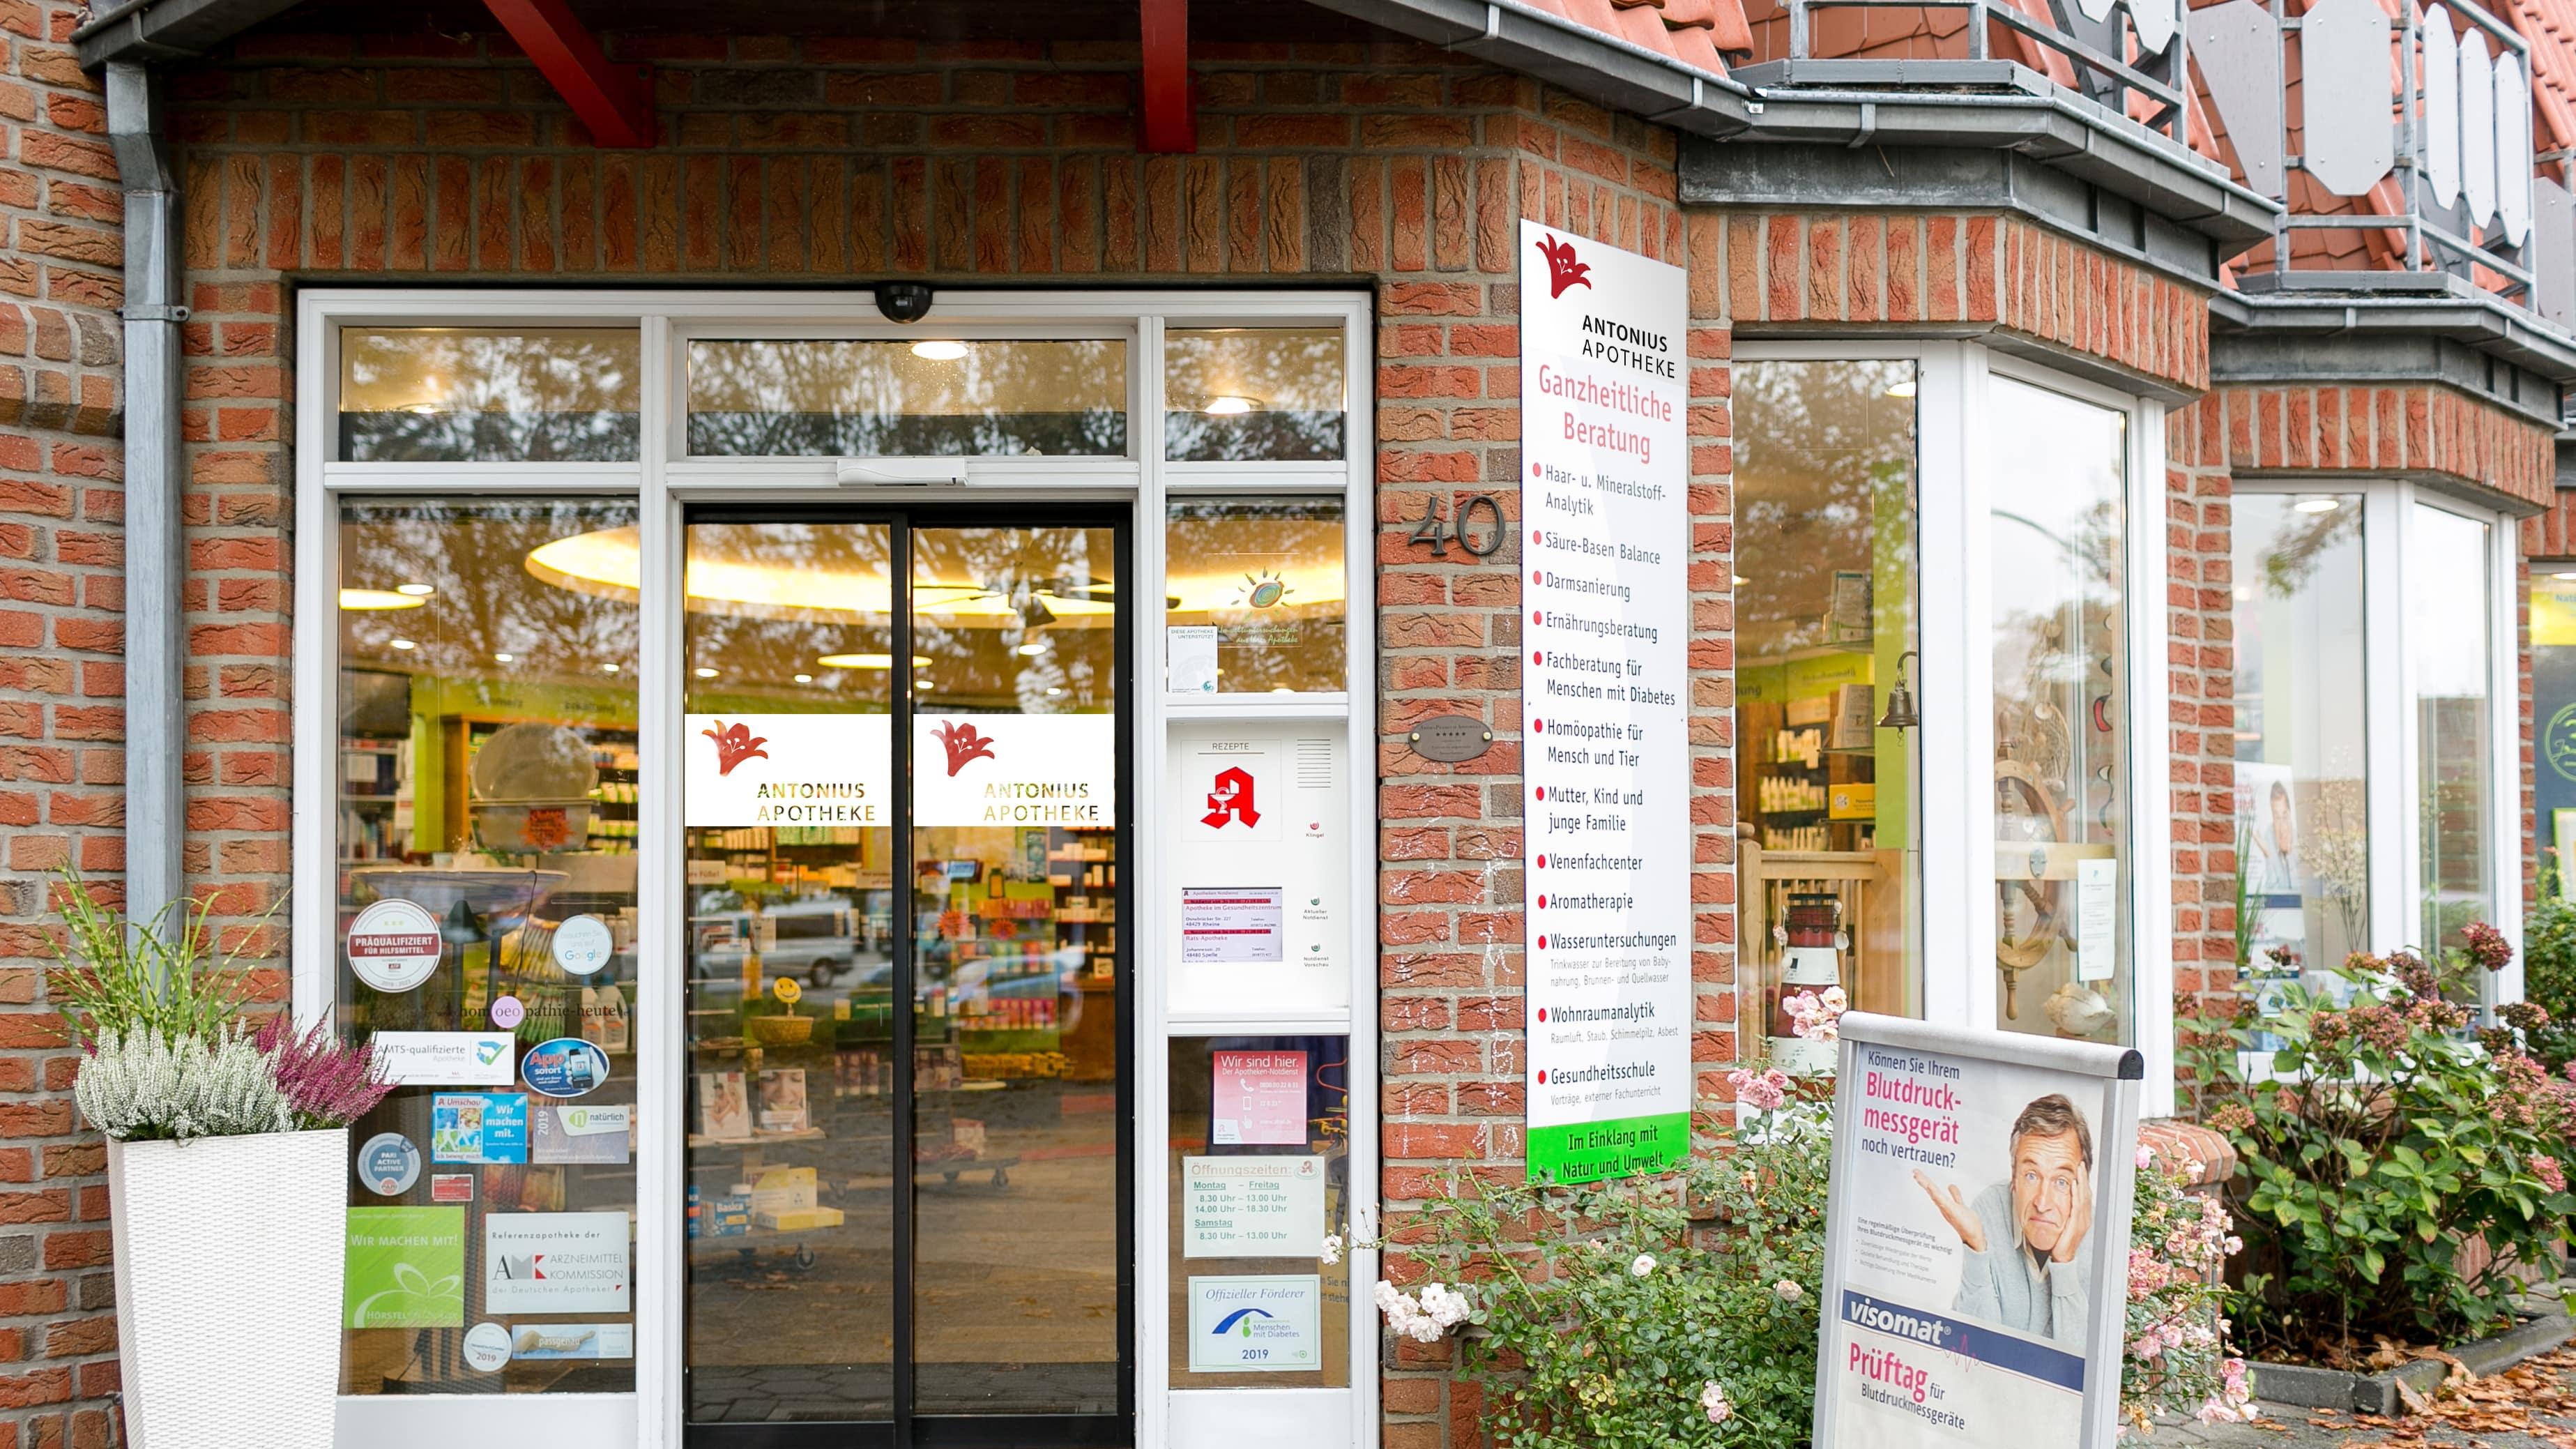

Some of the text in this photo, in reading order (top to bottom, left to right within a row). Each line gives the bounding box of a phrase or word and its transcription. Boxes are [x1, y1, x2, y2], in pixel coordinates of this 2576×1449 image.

[1583, 315, 1668, 351] ANTONIUS
[1583, 339, 1675, 379] APOTHEKE
[1539, 364, 1672, 421] Ganzheitliche
[1564, 411, 1650, 464] Beratung
[1546, 464, 1666, 501] Haar- u. Mineralstoff-
[1546, 492, 1594, 517] Analytik
[1407, 495, 1506, 556] 40
[1546, 531, 1661, 565] Säure-Basen Balance
[1546, 572, 1631, 602] Darmsanierung
[1546, 612, 1658, 644] Ernährungsberatung
[1547, 651, 1643, 678] Fachberatung für
[1547, 678, 1675, 706] Menschen mit Diabetes
[1548, 719, 1643, 741] Homöopathie für
[1548, 746, 1639, 766] Mensch und Tier
[756, 782, 865, 798] ANTONIUS
[984, 782, 1089, 798] ANTONIUS
[1548, 786, 1643, 805] Mutter, Kind und
[756, 805, 876, 821] APOTHEKE
[984, 805, 1099, 821] APOTHEKE
[1548, 812, 1626, 834] junge Familie
[1549, 853, 1643, 870] Venenfachcenter
[1550, 893, 1633, 913] Aromatherapie
[355, 936, 433, 946] PRÄQUALIFIZIERT
[1550, 931, 1677, 951] Wasseruntersuchungen
[379, 946, 425, 955] HILFSMITTEL
[1550, 958, 1589, 970] Trinkwasser
[1592, 960, 1602, 969] zur
[1605, 957, 1636, 970] Bereitung
[1617, 973, 1629, 985] und
[1631, 972, 1669, 984] Quellwasser
[1551, 1002, 1655, 1023] Wohnraumanalytik
[1658, 1026, 1679, 1037] Asbest
[378, 1045, 465, 1054] AMTS-qualifizierte
[529, 1052, 565, 1067] App
[1221, 1055, 1298, 1067] Wir sind hier.
[1868, 1051, 1960, 1079] Können Sie Ihrem
[535, 1067, 562, 1075] sofort
[1551, 1061, 1655, 1085] Gesundheitsschule
[1550, 1086, 1661, 1106] Vorträge, externer Fachunterricht
[1866, 1071, 1961, 1111] Blutdruck-
[447, 1098, 481, 1107] Umschau
[496, 1105, 515, 1115] Wir
[486, 1116, 524, 1127] machen
[538, 1110, 548, 1136] 2019
[589, 1112, 625, 1122] natürlich
[1864, 1107, 1959, 1144] messgerät
[494, 1128, 515, 1138] mit.
[1569, 1124, 1658, 1151] Im Einklang mit
[1861, 1137, 1956, 1169] noch vertrauen?
[1191, 1162, 1292, 1177] Öffnungszeiten:
[1562, 1151, 1663, 1178] Natur und Umwelt
[1194, 1181, 1280, 1190] Montag Freitag
[1247, 1194, 1270, 1202] 13.00
[1271, 1194, 1288, 1202] Uhr
[1195, 1205, 1217, 1213] 14.00
[1247, 1204, 1270, 1213] 18.30
[1271, 1204, 1288, 1213] Uhr
[1194, 1219, 1233, 1228] Samstag
[1857, 1216, 1868, 1225] Eine
[1900, 1225, 1936, 1243] Überprüfung
[351, 1234, 458, 1246] WIR MACHEN MIT!
[491, 1231, 580, 1241] Referenzapotheke
[1247, 1231, 1270, 1240] 13.00
[1271, 1231, 1288, 1240] Uhr
[1870, 1228, 1922, 1247] Blutdruckmessgerät
[549, 1254, 623, 1264] ARZNEIMITTEL
[549, 1269, 624, 1280] KOMMISSION
[491, 1285, 611, 1295] der Deutschen Apotheker
[1205, 1288, 1305, 1300] Offizieller Förderer
[476, 1353, 496, 1362] 2019
[1242, 1349, 1269, 1359] 2019
[1850, 1342, 1945, 1403] Prüftag für
[1861, 1383, 1965, 1430] Blutdruckmessgeräte
